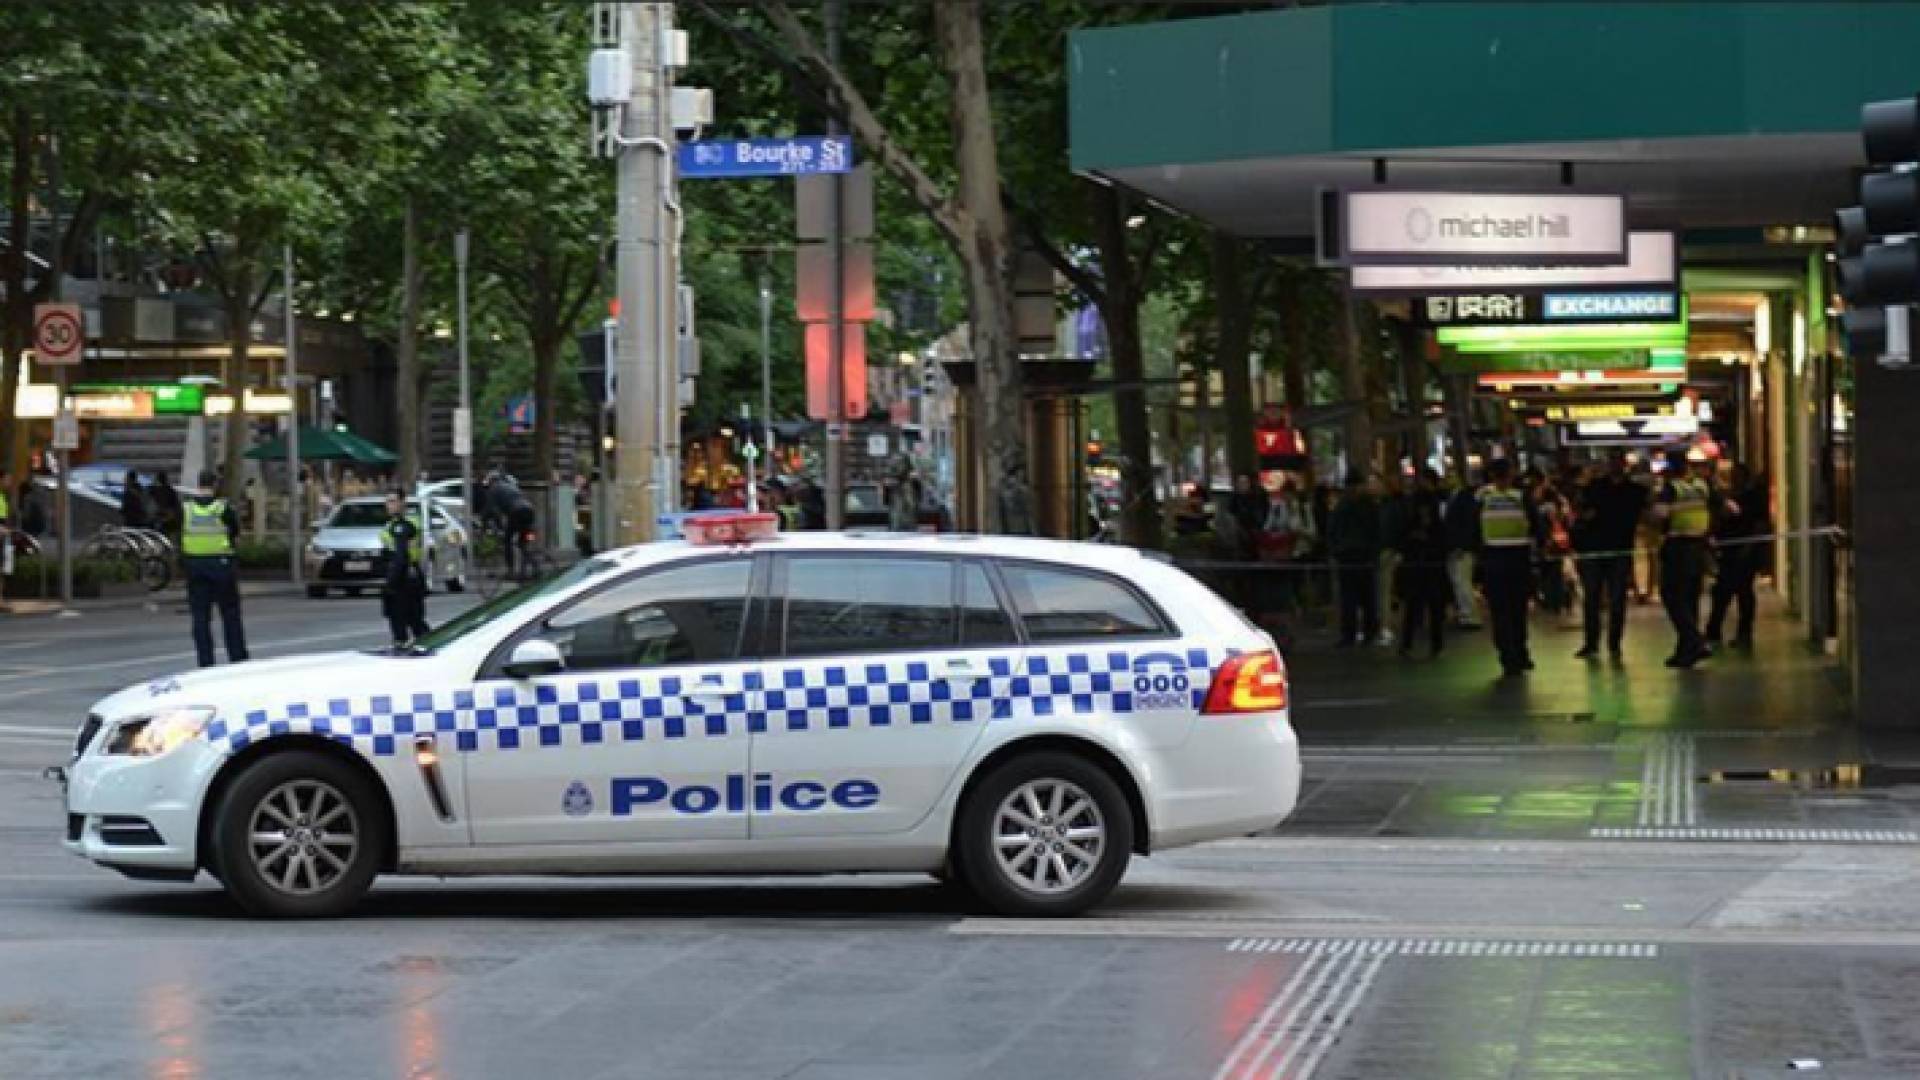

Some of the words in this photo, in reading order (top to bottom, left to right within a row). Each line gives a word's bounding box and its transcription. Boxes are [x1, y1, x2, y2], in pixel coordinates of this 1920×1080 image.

[736, 141, 814, 163] Bourke
[821, 139, 845, 159] St
[1438, 213, 1533, 238] michael
[1538, 214, 1570, 238] hill
[1549, 295, 1674, 315] EXCHANGE
[46, 323, 71, 344] 30
[1133, 674, 1189, 693] 000
[610, 772, 881, 816] Police
